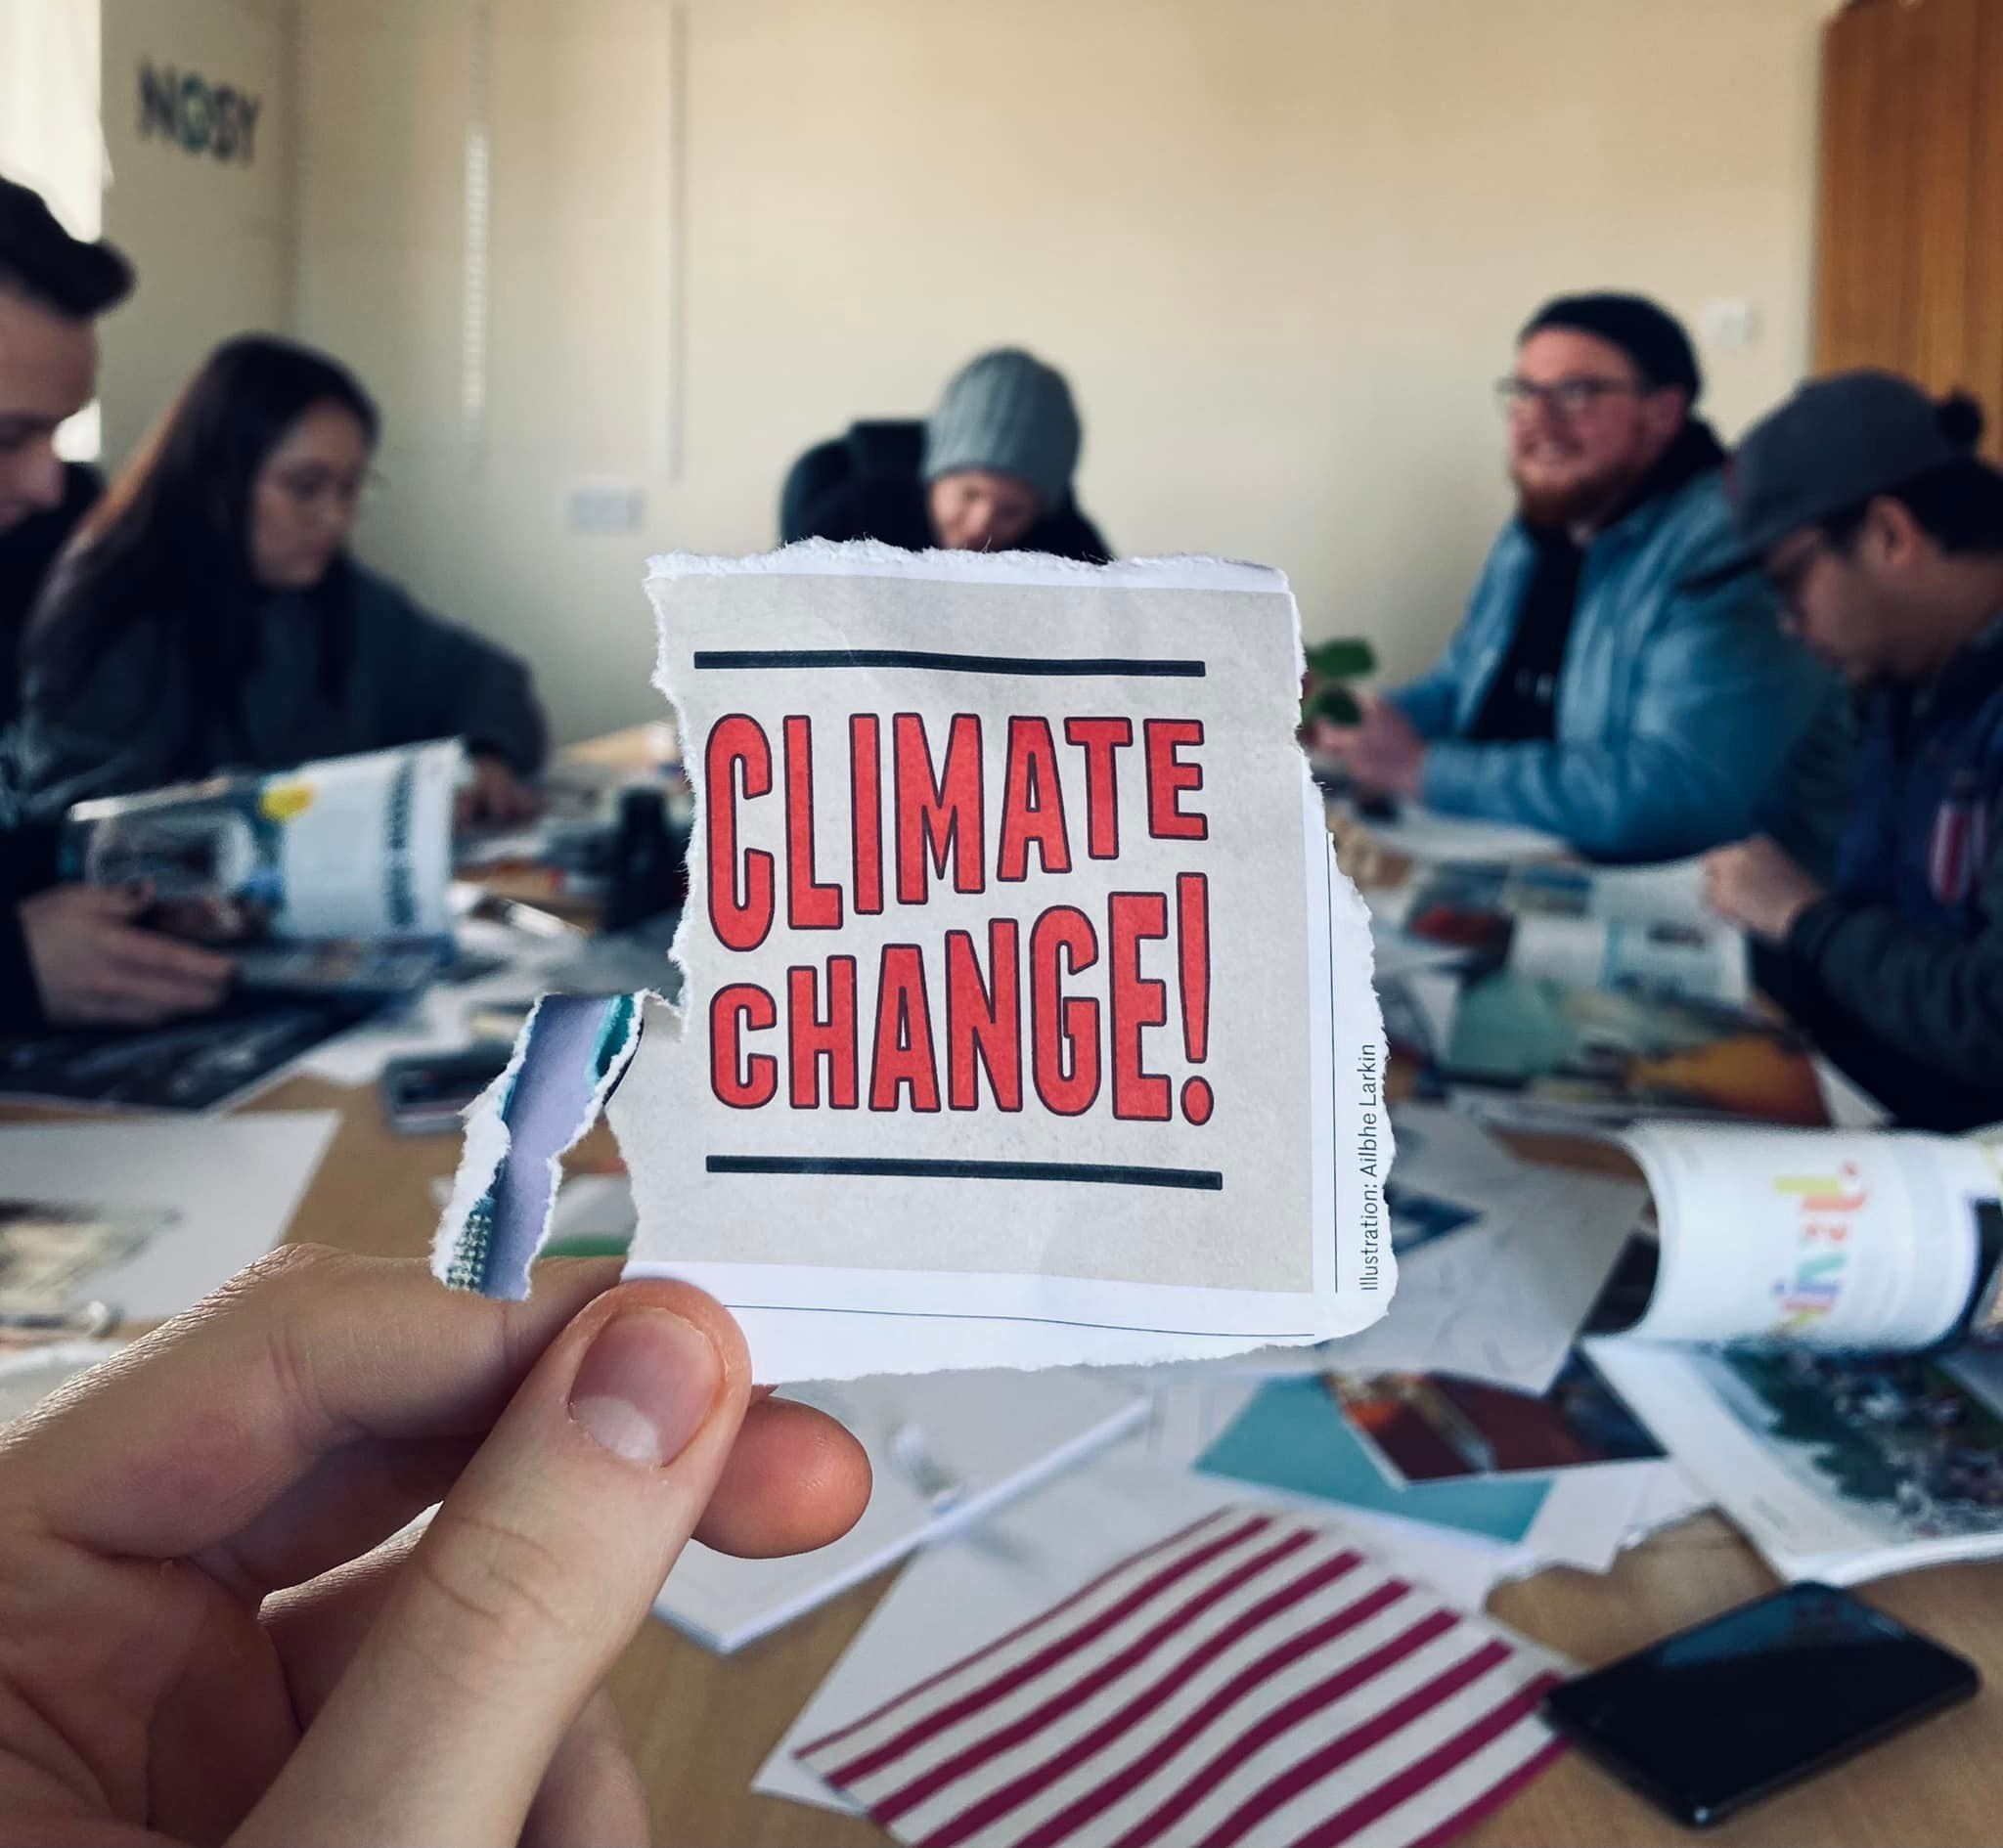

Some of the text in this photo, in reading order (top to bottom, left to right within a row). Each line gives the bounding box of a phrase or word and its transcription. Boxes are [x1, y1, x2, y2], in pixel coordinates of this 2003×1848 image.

[705, 713, 1209, 951] CLIMATE
[709, 872, 1215, 1126] CHANGE!
[1356, 1043, 1378, 1291] Illustration: Ailbhe Larkin
